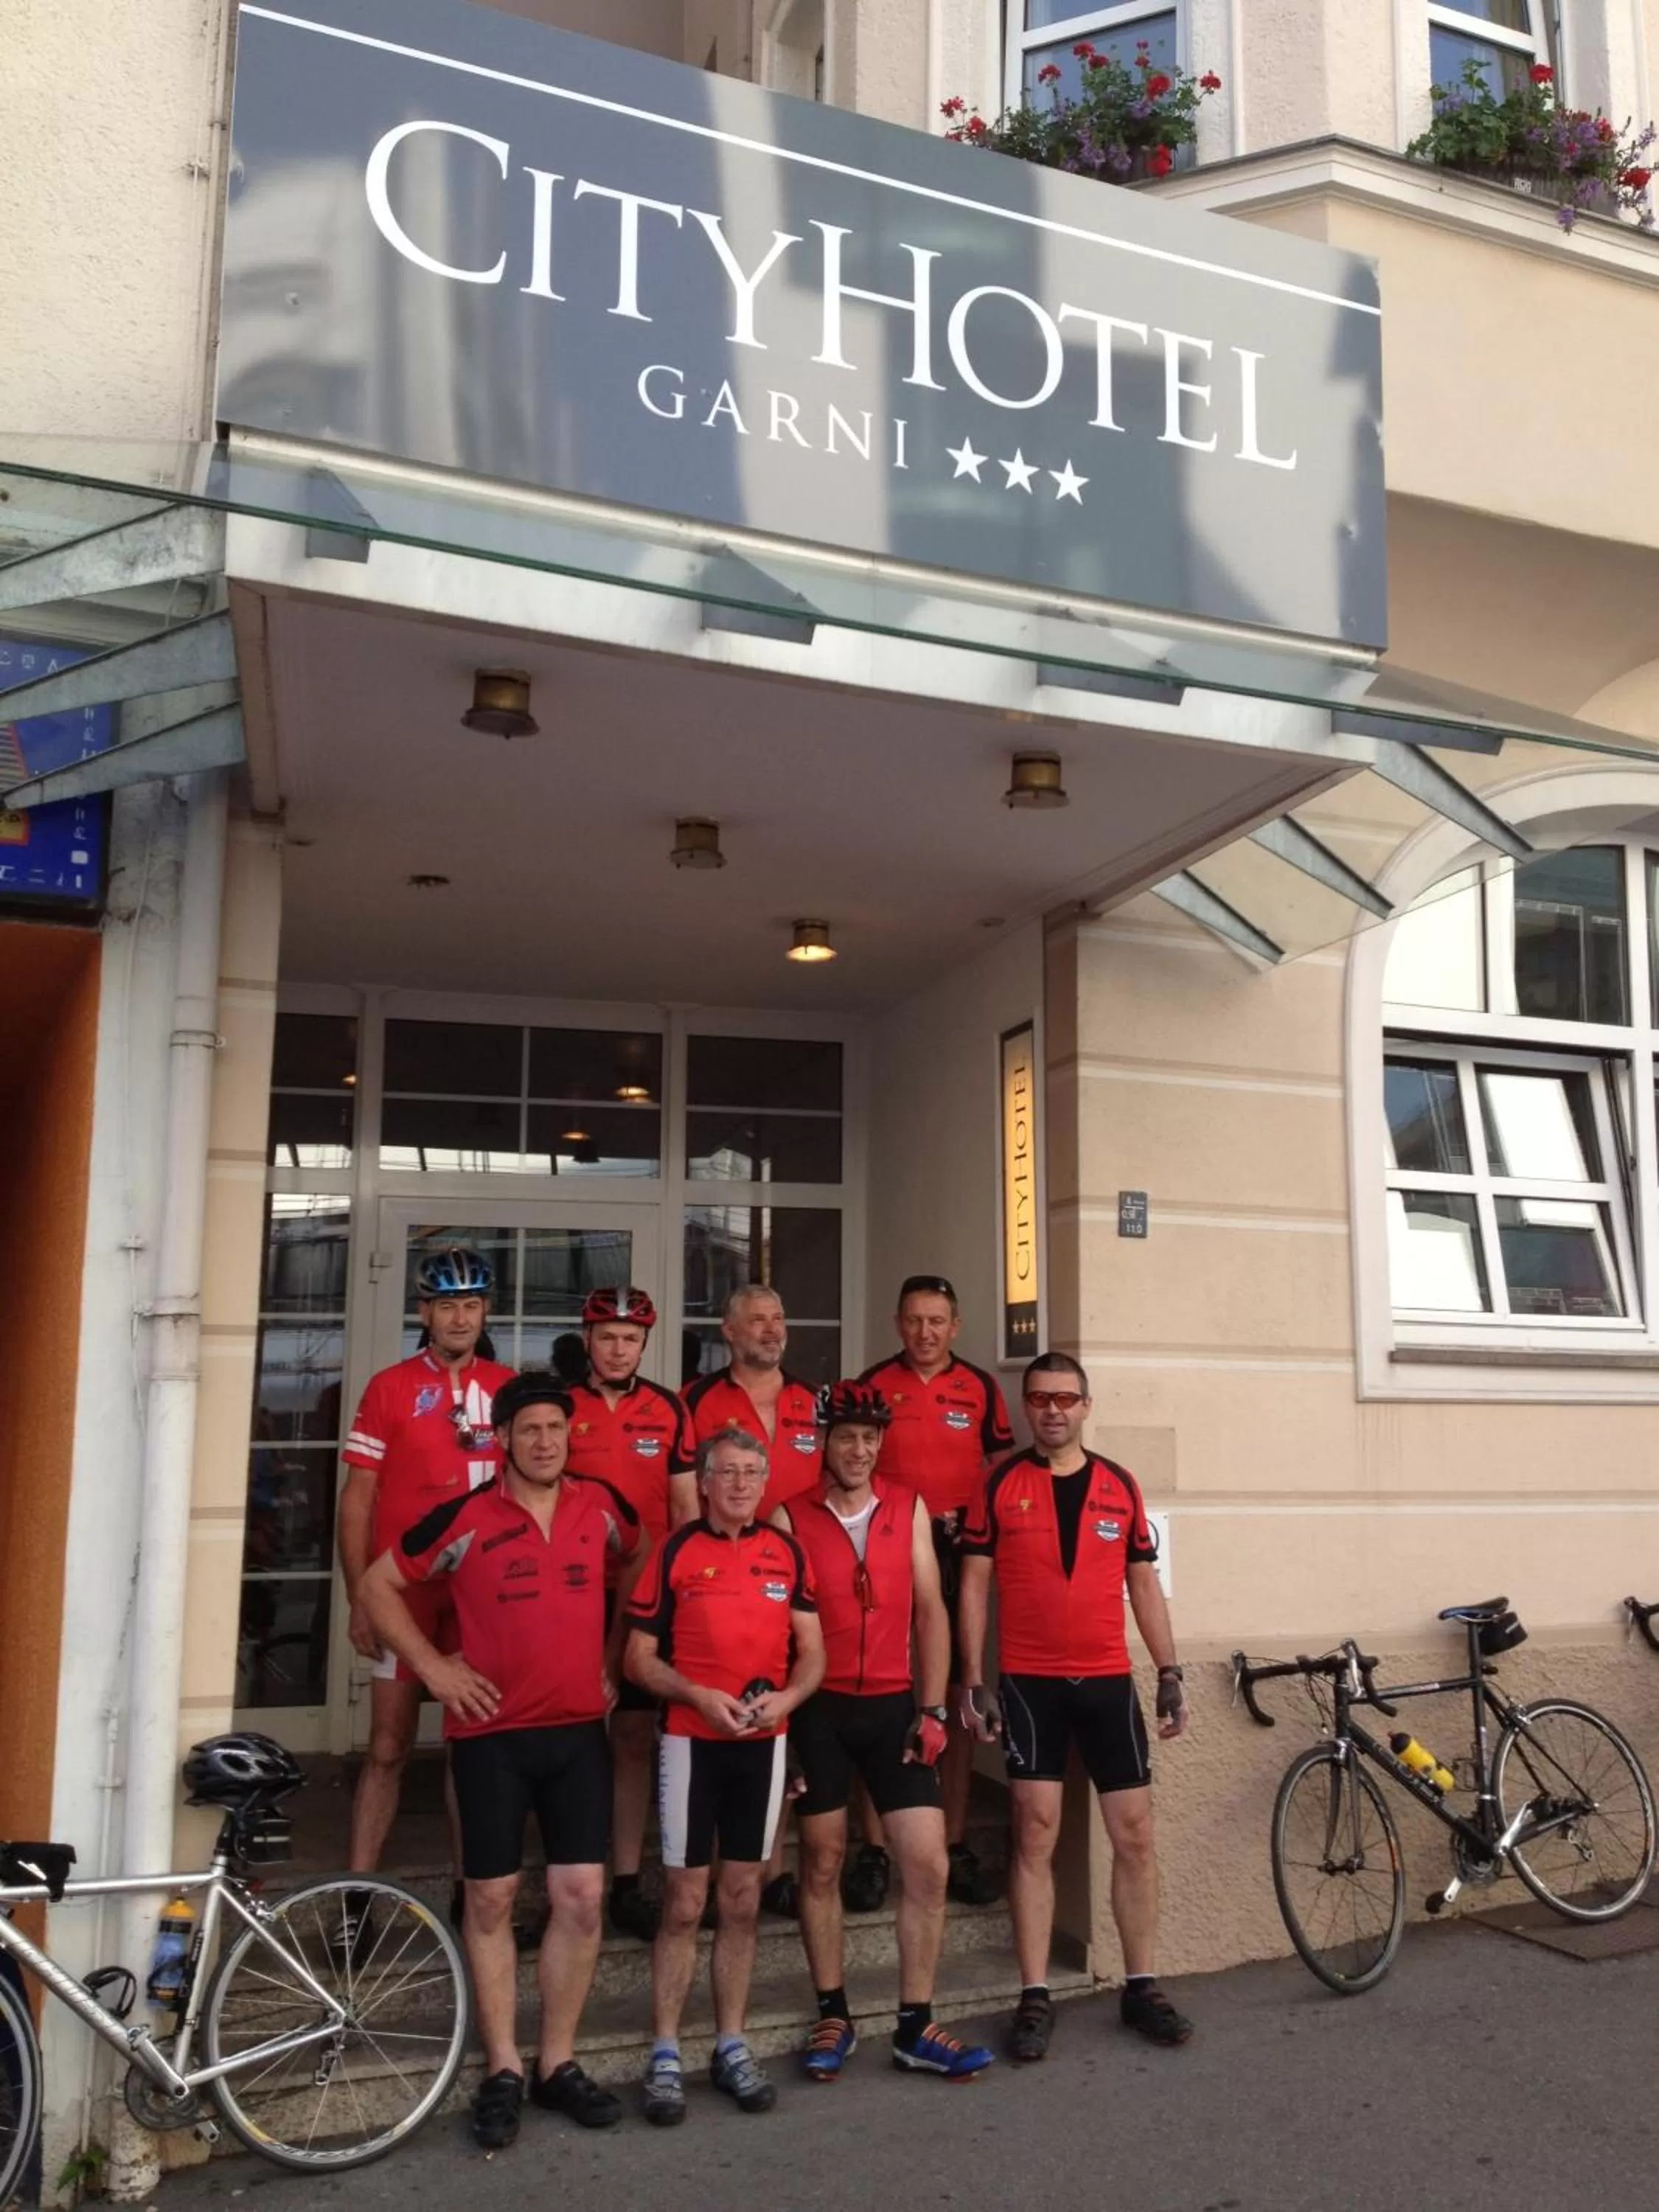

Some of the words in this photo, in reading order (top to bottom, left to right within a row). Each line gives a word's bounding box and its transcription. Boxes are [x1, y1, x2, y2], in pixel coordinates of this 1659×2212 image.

[364, 120, 1298, 470] CITYHOTEL
[638, 364, 908, 470] GARNI
[1014, 1055, 1030, 1281] CITYHOTEL
